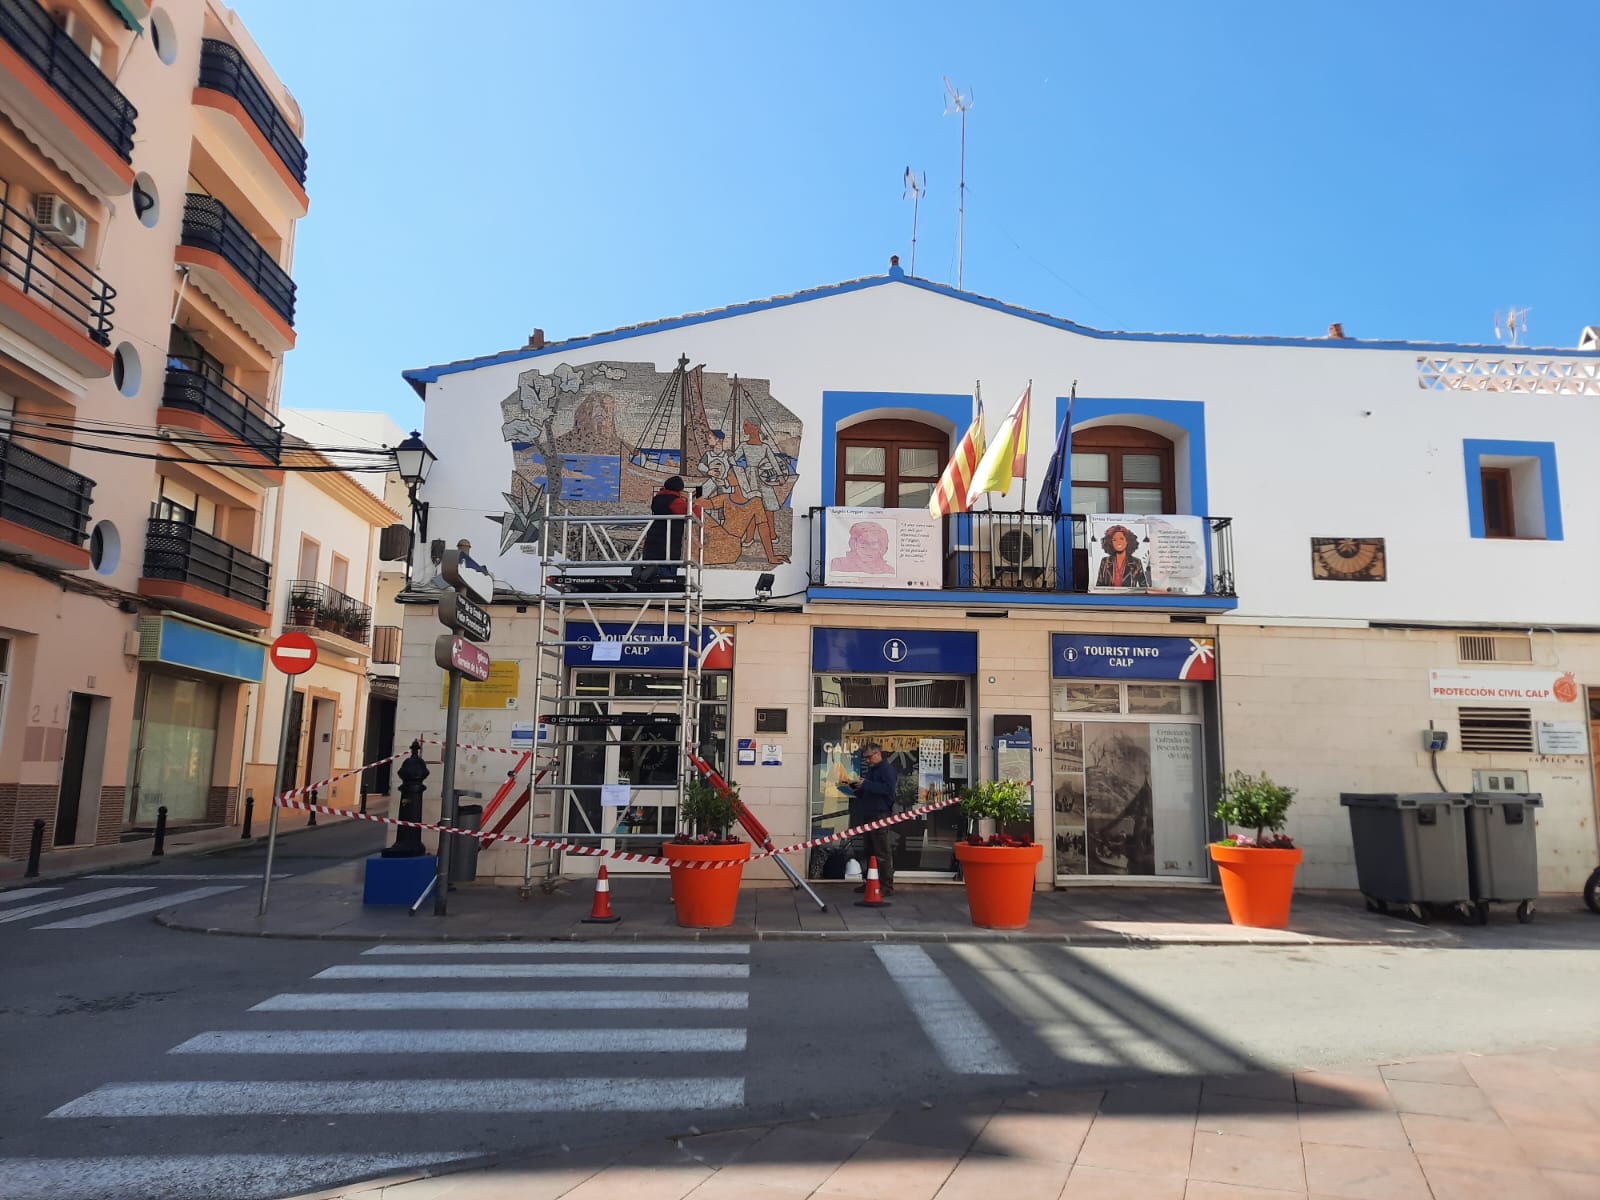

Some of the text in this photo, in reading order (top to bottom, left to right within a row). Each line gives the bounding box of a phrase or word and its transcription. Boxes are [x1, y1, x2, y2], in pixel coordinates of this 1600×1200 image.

[624, 646, 650, 655] CALP
[1084, 646, 1159, 657] TOURIST INFO
[1109, 657, 1134, 667] CALP
[1498, 688, 1523, 698] CIVIL
[1525, 689, 1550, 698] CALP
